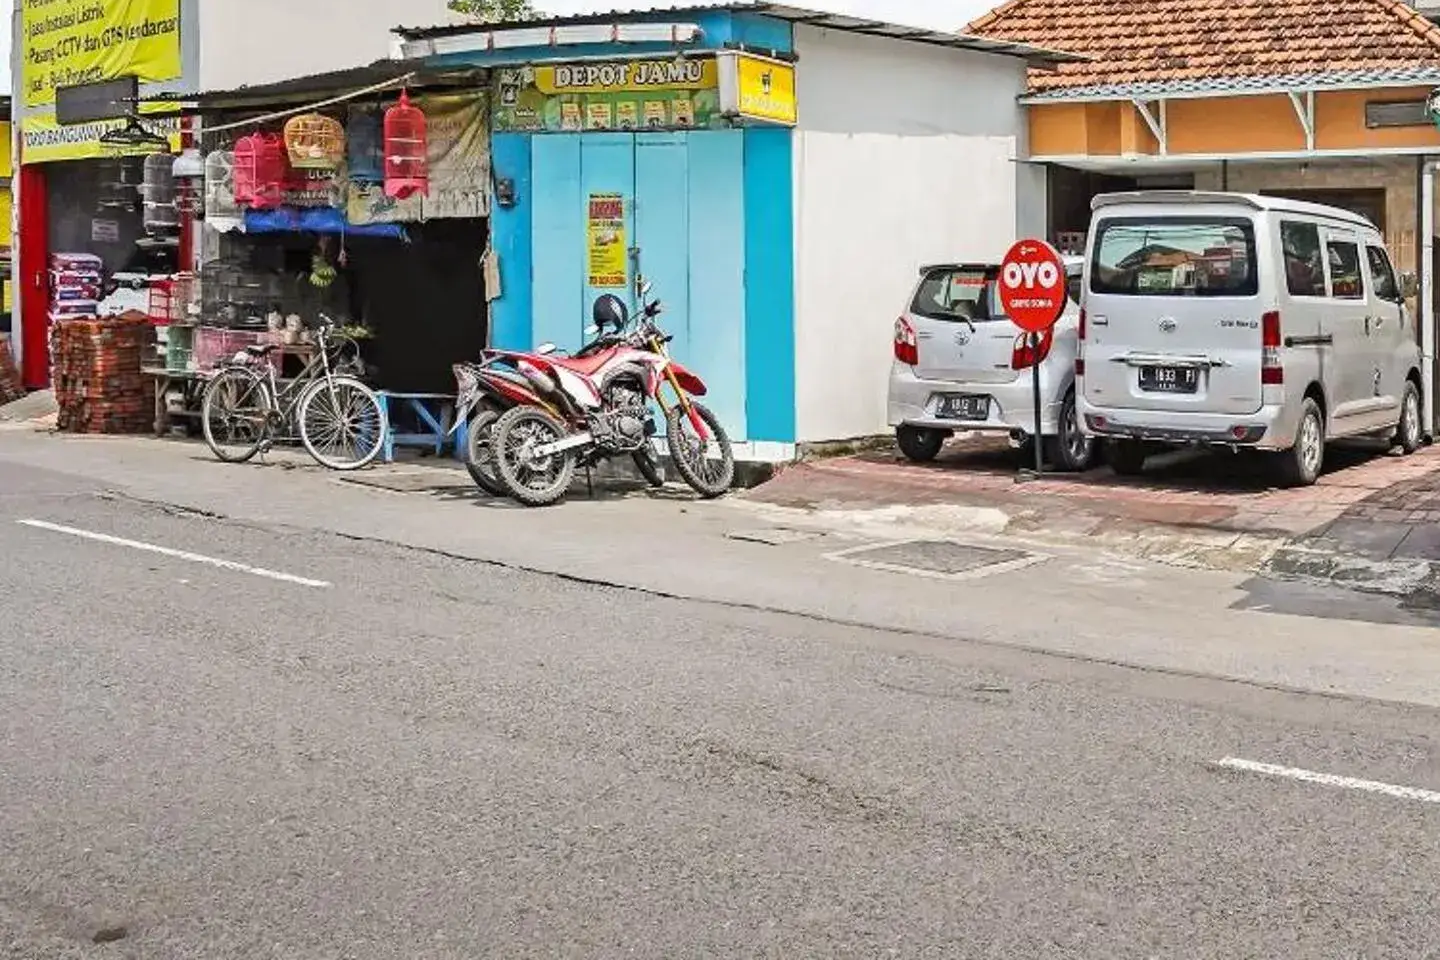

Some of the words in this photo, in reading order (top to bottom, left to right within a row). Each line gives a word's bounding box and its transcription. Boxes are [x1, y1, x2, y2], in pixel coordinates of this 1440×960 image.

[57, 35, 82, 58] CCTV
[554, 62, 630, 89] DEPOT
[634, 58, 705, 86] JAMU
[1003, 261, 1059, 289] OYO
